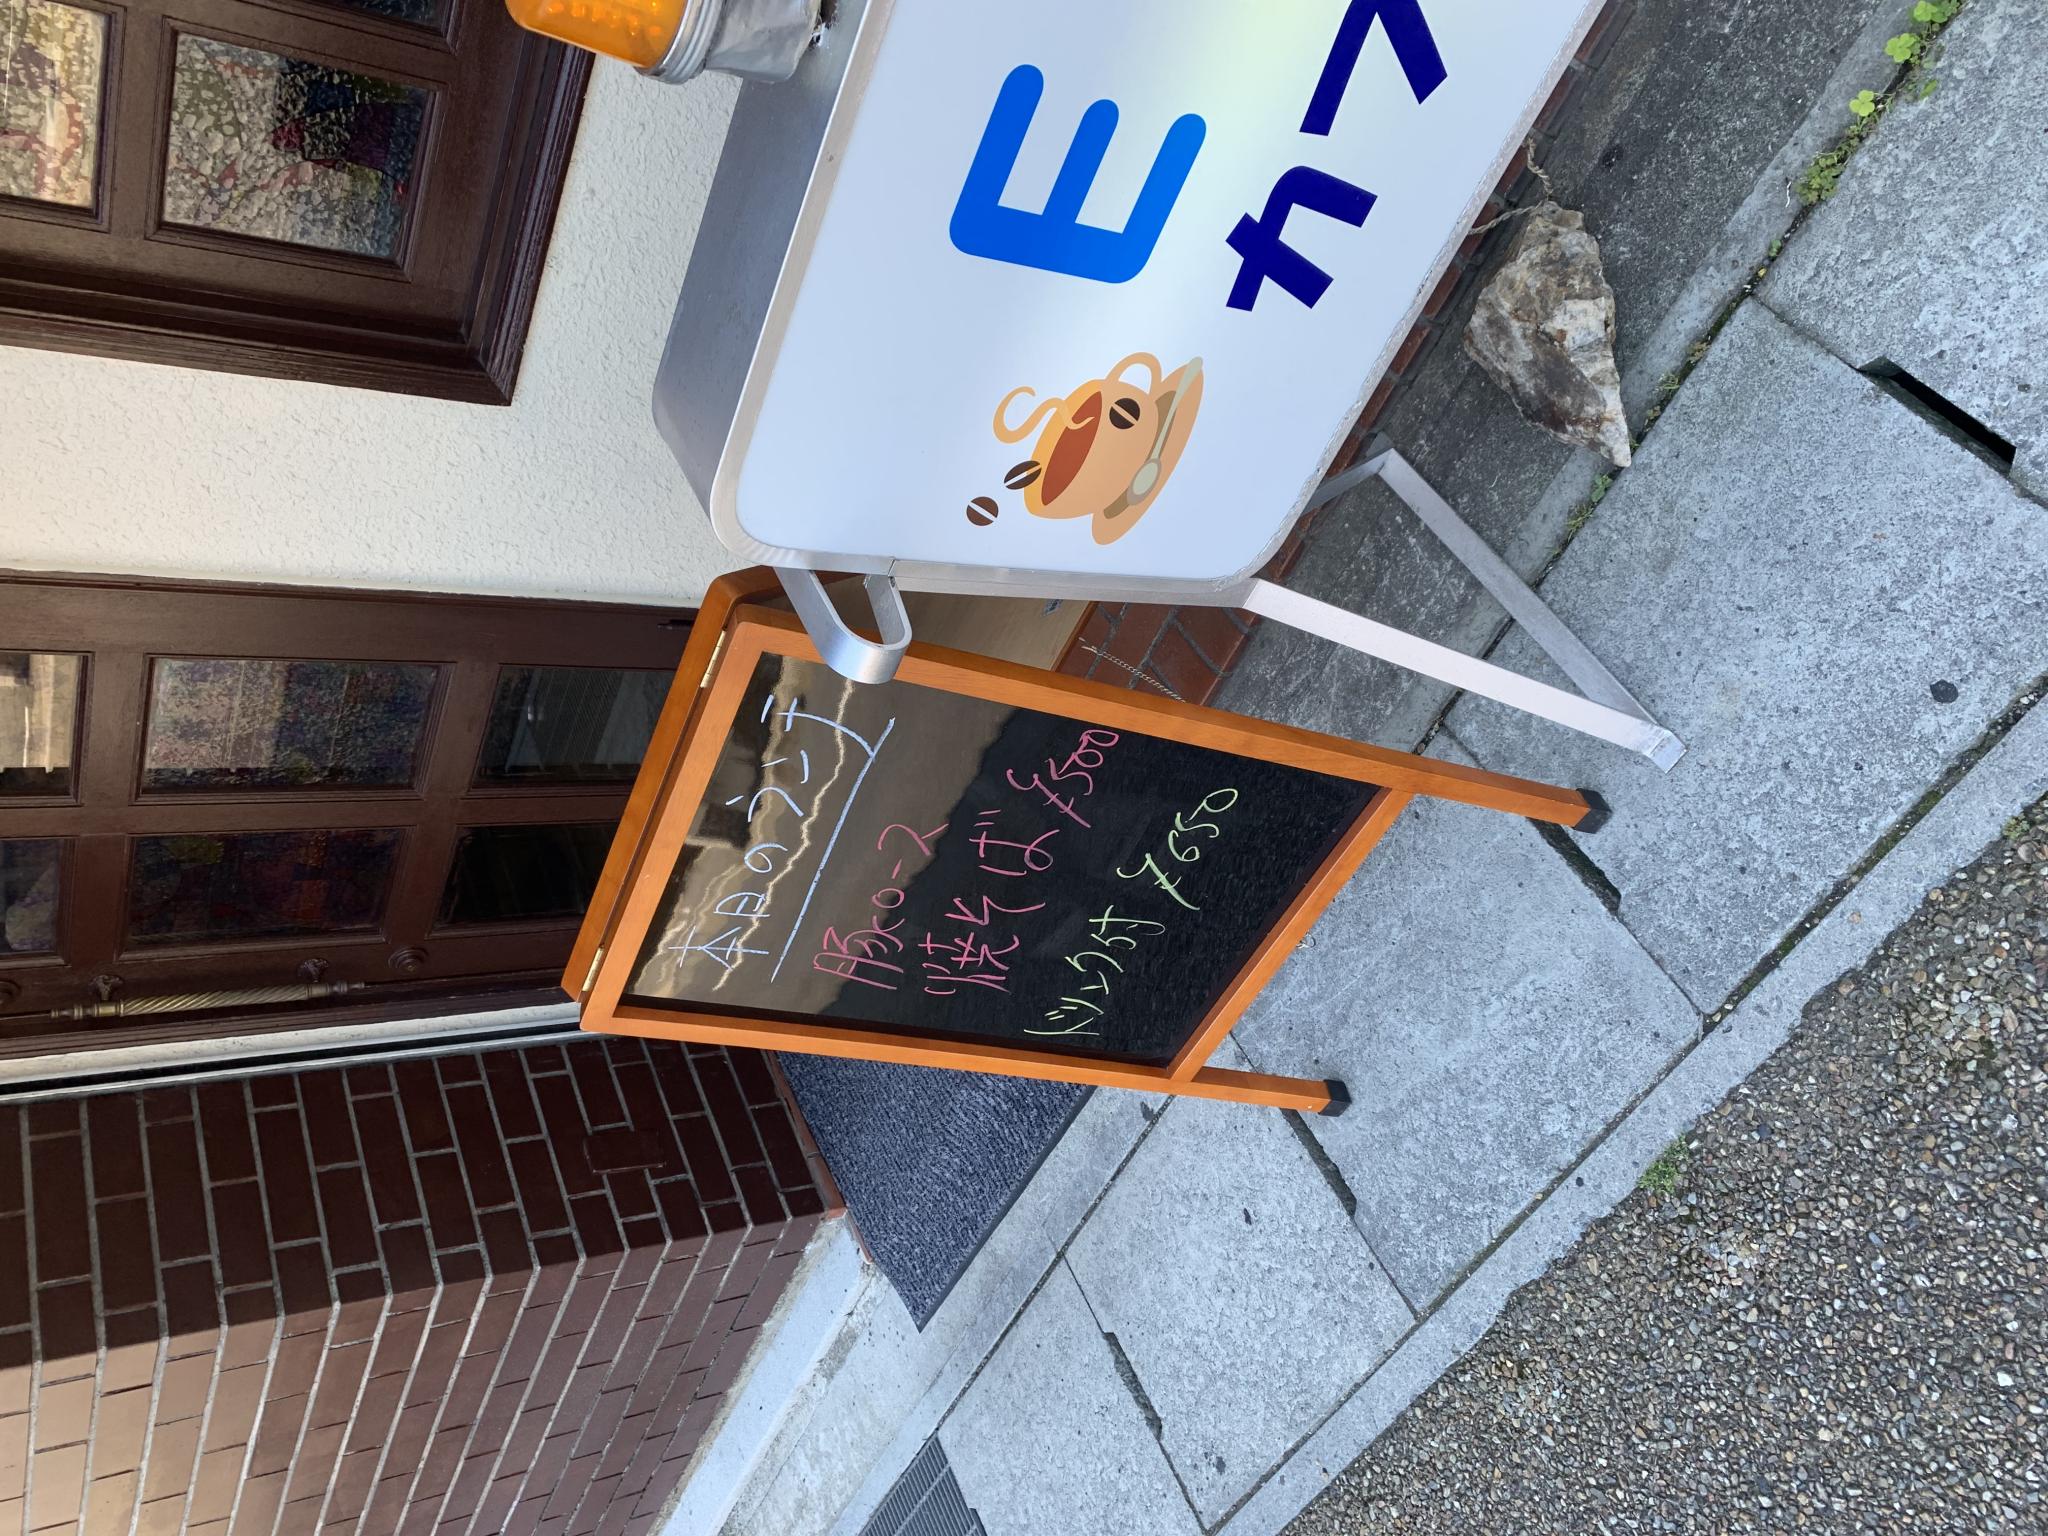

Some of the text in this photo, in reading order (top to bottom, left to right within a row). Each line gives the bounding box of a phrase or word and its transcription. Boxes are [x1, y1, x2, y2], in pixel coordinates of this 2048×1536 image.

[949, 64, 1206, 284] E
[1226, 0, 1448, 312] カフ
[668, 694, 876, 972] 本日のランチ
[813, 823, 949, 990] 豚ロース
[917, 729, 1119, 996] 焼そば ¥500
[1023, 788, 1239, 1036] ドリンク付 ¥650
